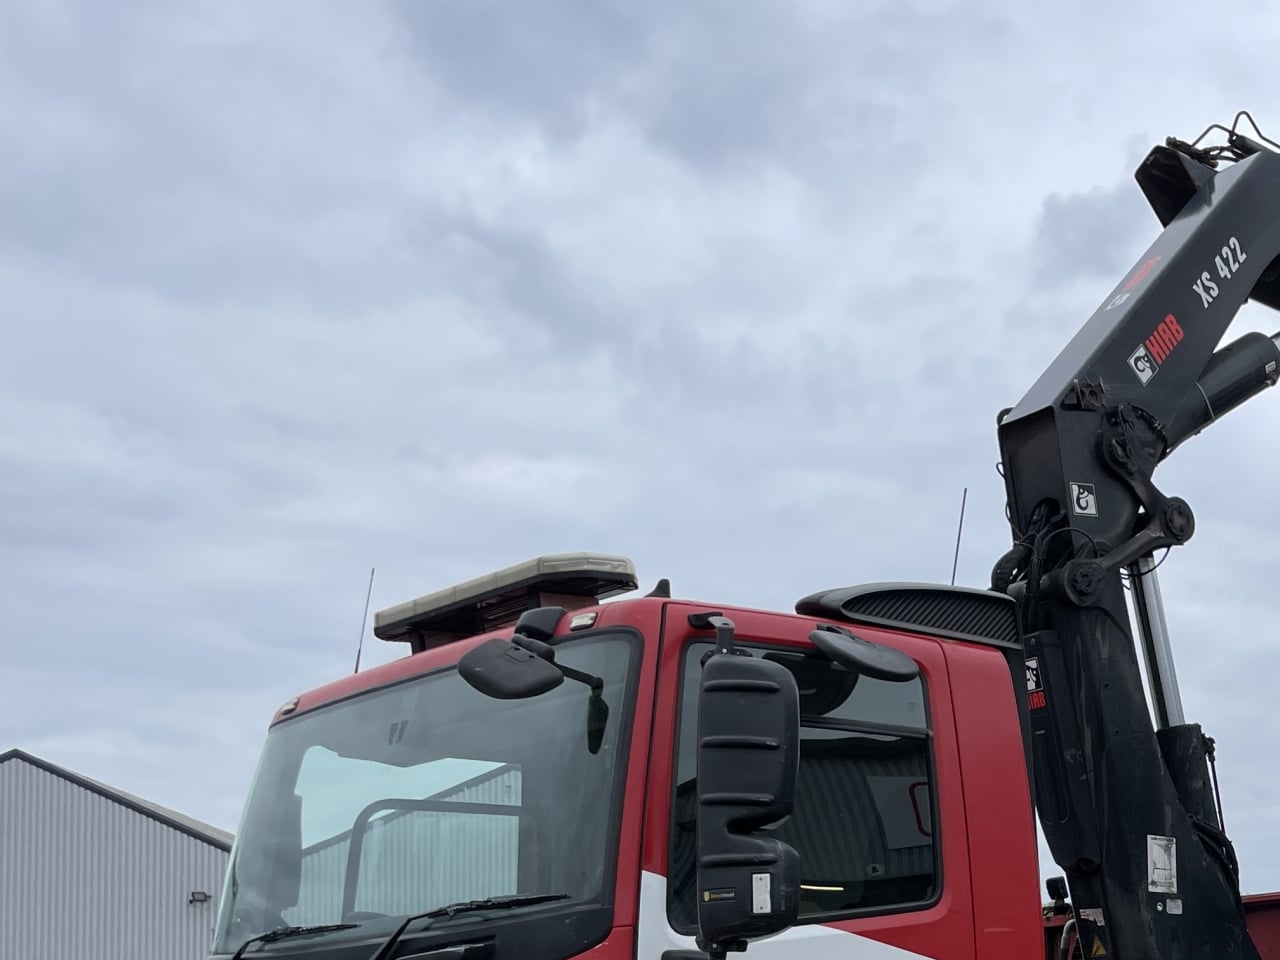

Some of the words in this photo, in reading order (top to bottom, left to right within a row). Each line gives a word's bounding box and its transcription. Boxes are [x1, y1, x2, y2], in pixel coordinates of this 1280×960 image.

[1192, 271, 1219, 309] XS
[1214, 236, 1247, 280] 422
[1145, 313, 1184, 365] HIAB
[1028, 691, 1046, 711] IAB
